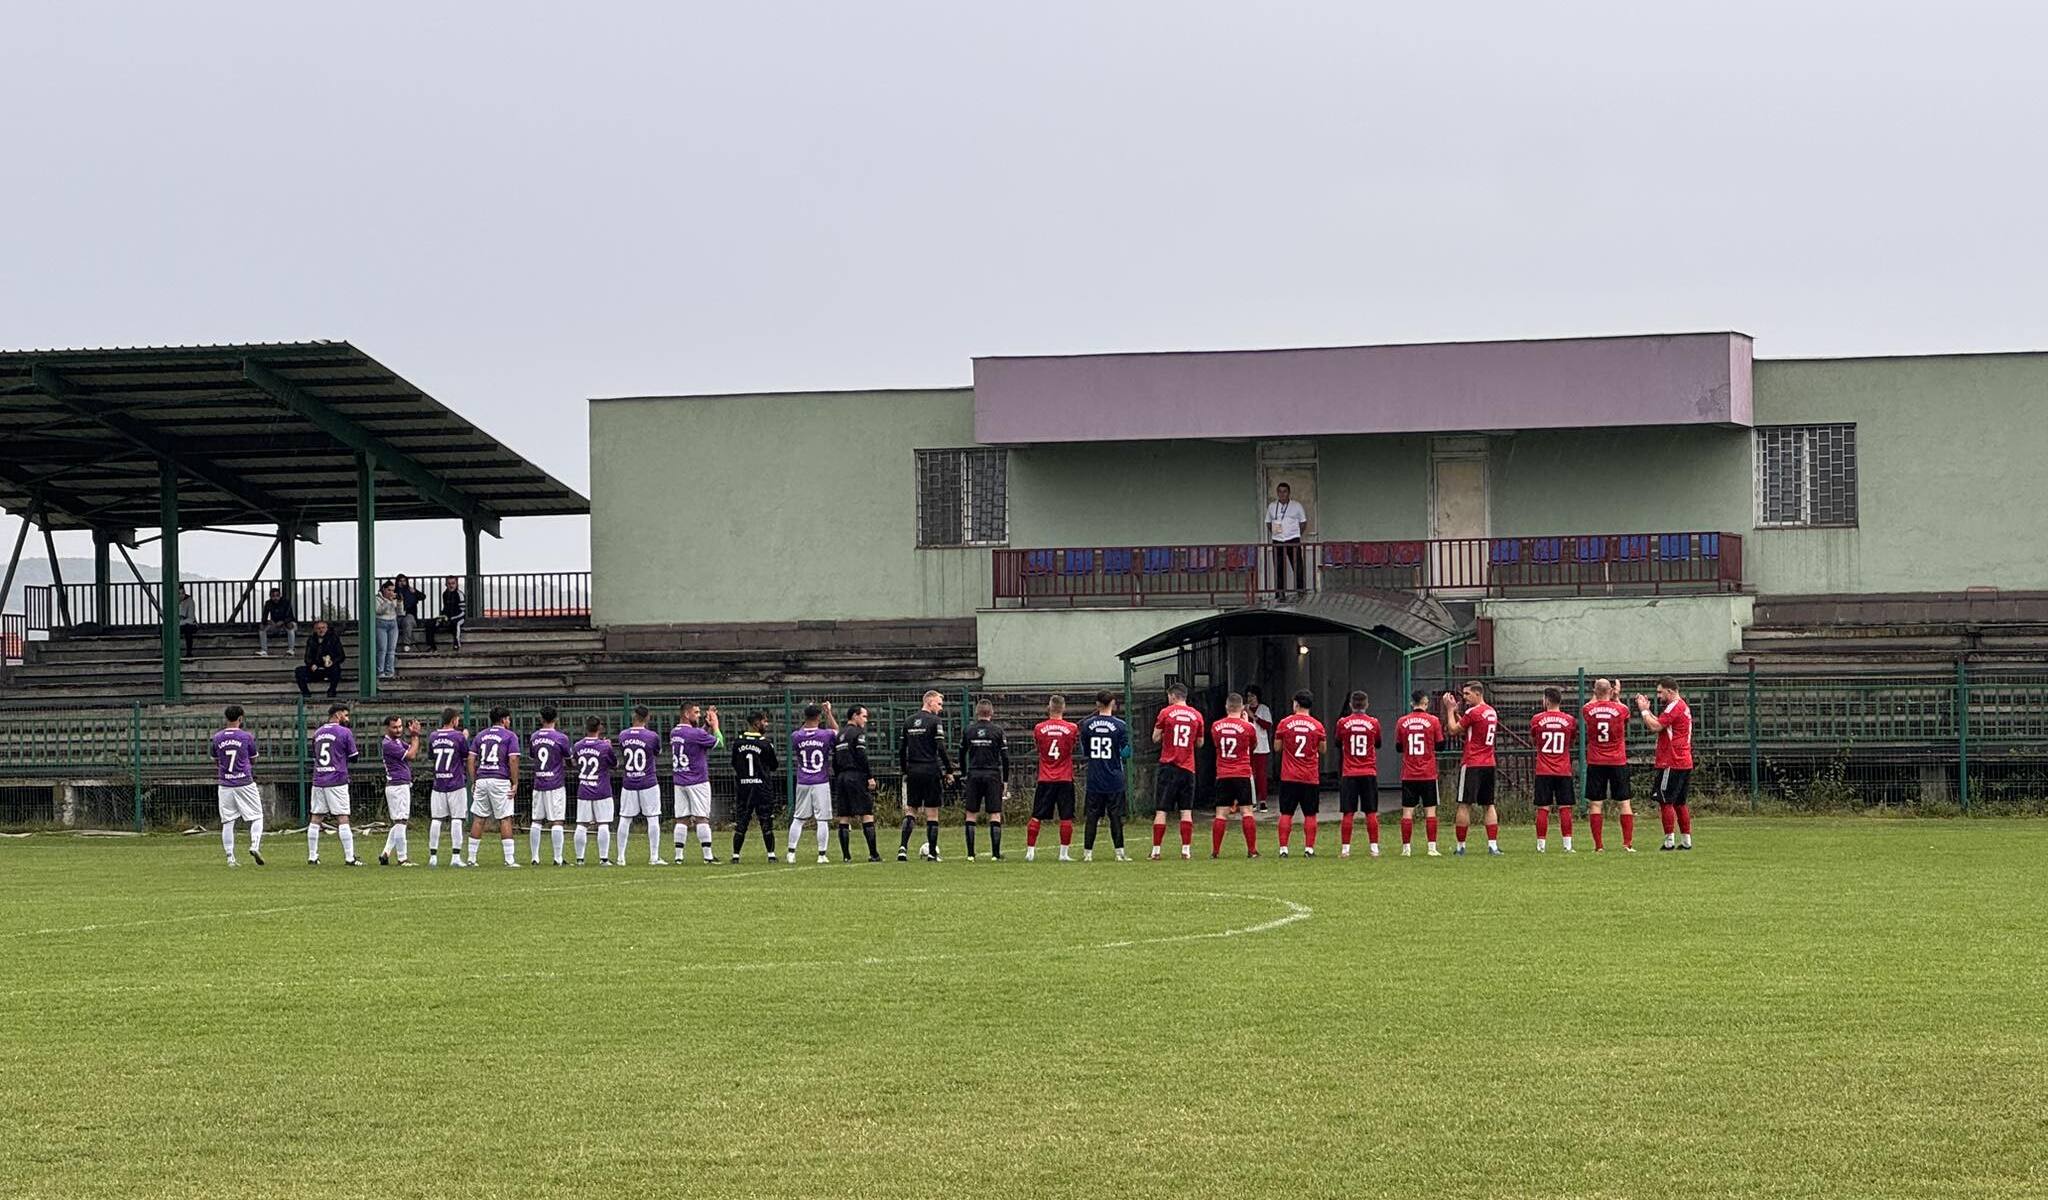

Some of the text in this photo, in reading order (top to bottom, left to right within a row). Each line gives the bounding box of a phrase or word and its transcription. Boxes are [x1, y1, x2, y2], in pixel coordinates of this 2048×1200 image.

[1173, 723, 1191, 747] 13
[1485, 723, 1496, 746] 6
[1541, 731, 1565, 754] 20
[1597, 722, 1610, 743] 3
[319, 743, 331, 767] 5
[480, 743, 500, 765] 14
[1048, 739, 1060, 760] 4
[1090, 736, 1112, 759] 93
[1220, 736, 1238, 758] 12
[1294, 735, 1307, 758] 2
[1350, 734, 1368, 757] 19
[1407, 733, 1425, 756] 15
[225, 750, 237, 773] 7
[433, 748, 455, 771] 77
[537, 747, 549, 771] 9
[578, 756, 599, 780] 22
[623, 747, 647, 772] 20
[746, 753, 754, 777] 1
[799, 749, 825, 771] 10
